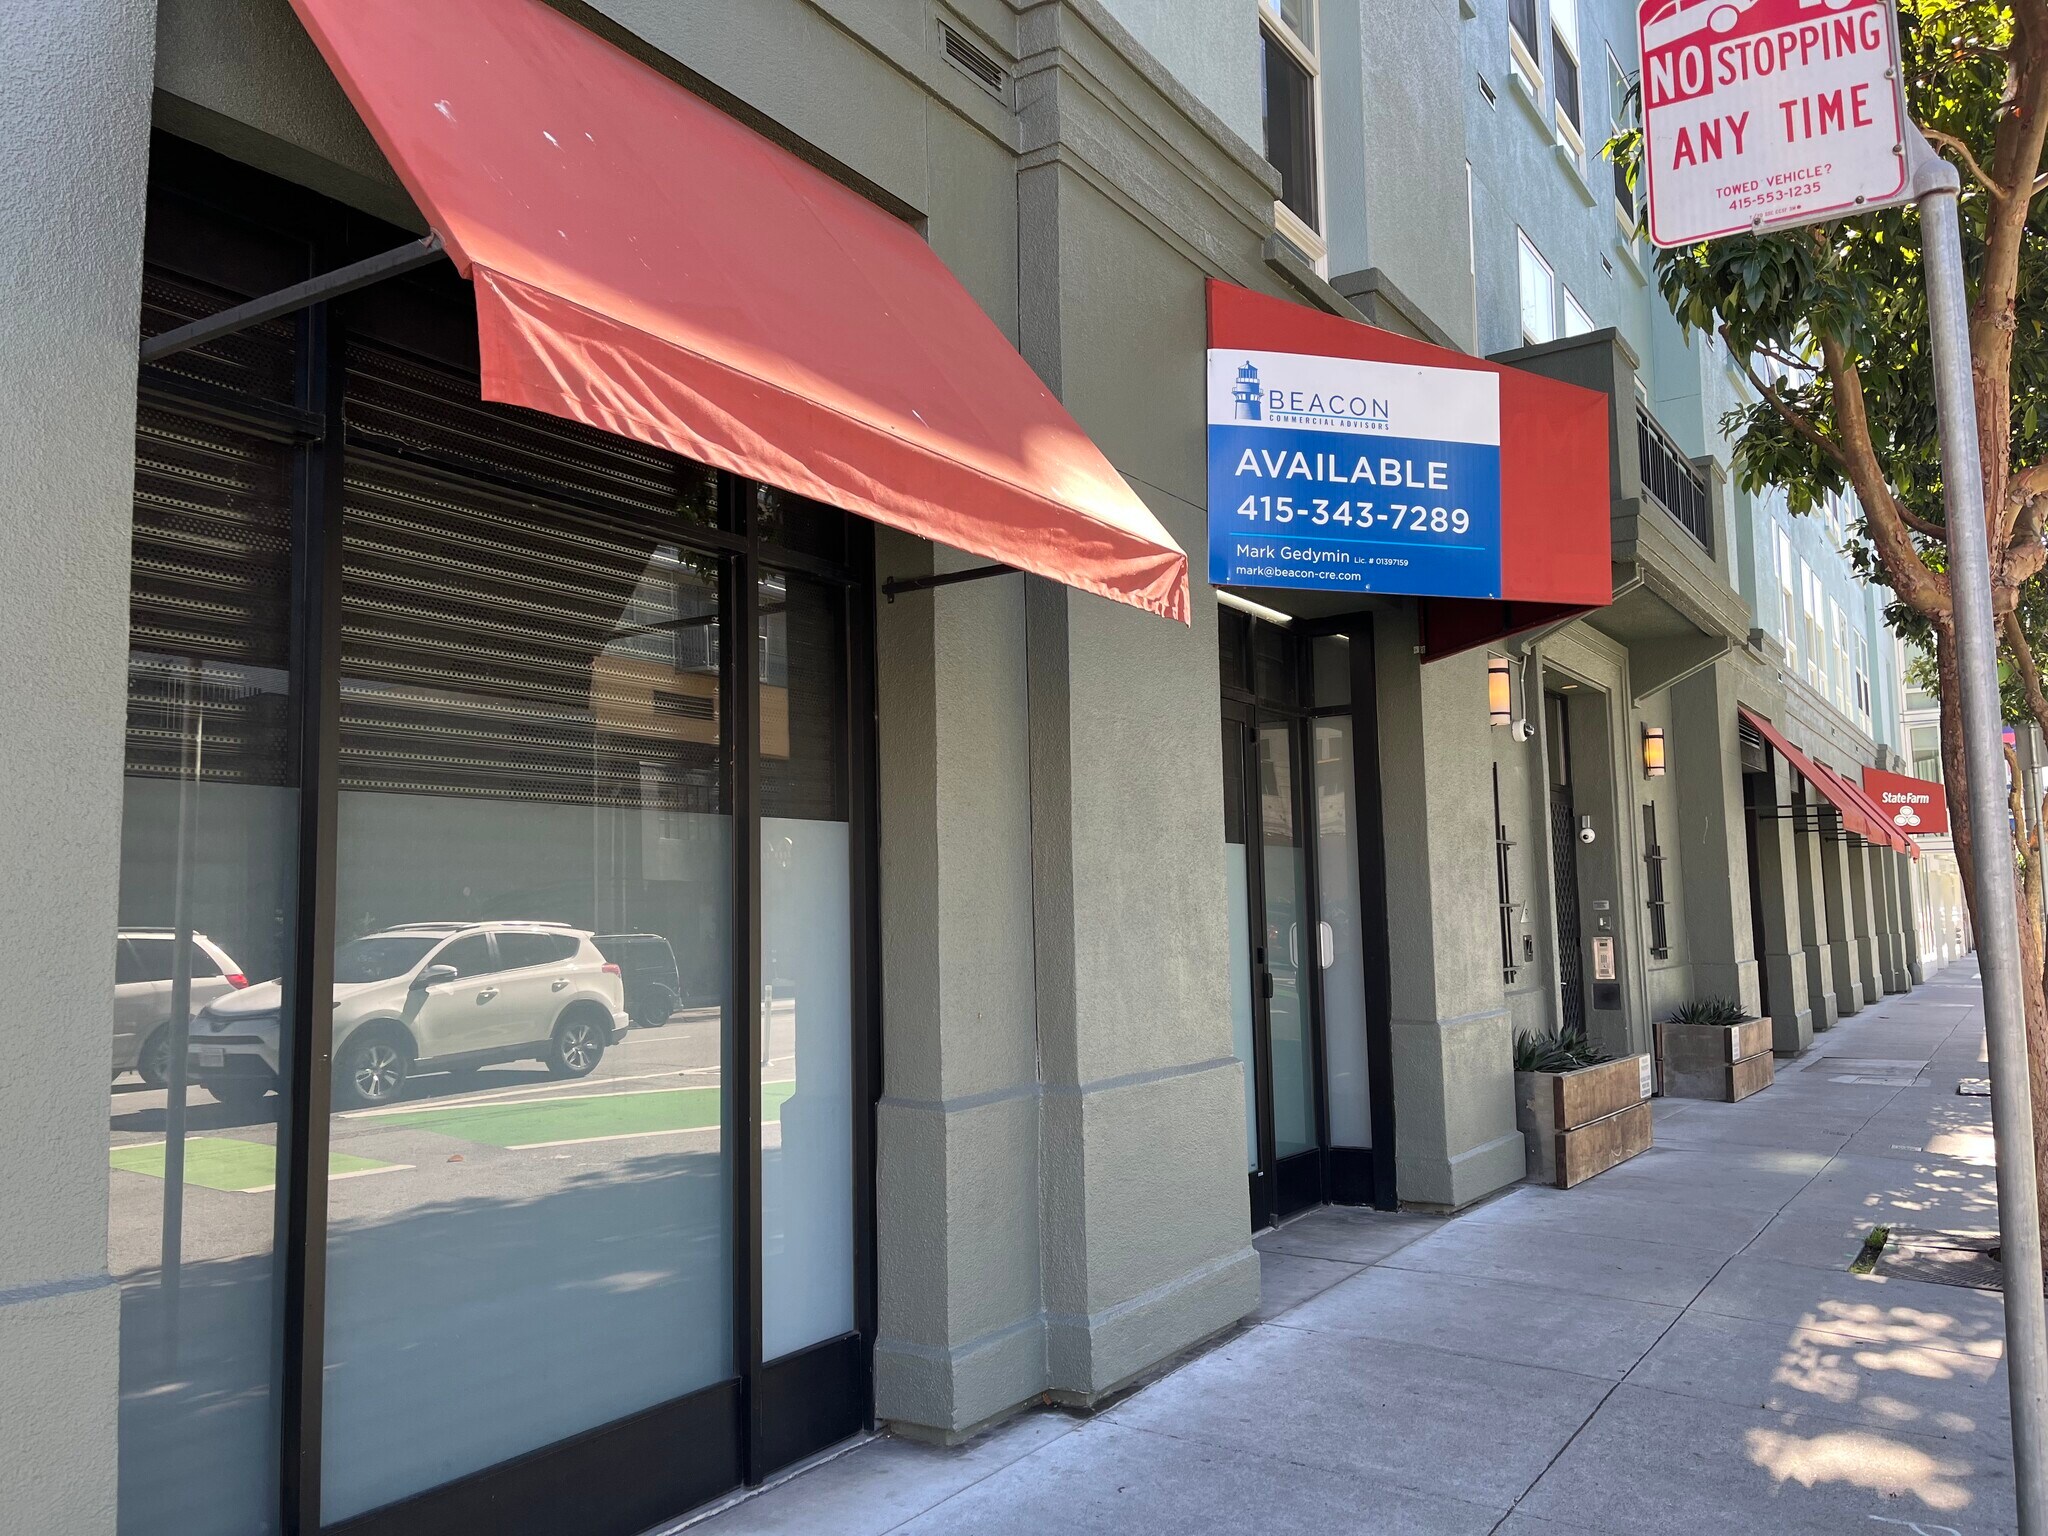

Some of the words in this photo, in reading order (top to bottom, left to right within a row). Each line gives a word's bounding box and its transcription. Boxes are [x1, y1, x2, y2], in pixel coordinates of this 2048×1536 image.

[1650, 45, 1705, 104] NO
[1717, 10, 1881, 86] STOPPING
[1672, 111, 1750, 170] ANY
[1779, 82, 1873, 143] TIME
[1716, 180, 1759, 199] TOWED
[1766, 163, 1833, 188] VEHICLE?
[1729, 182, 1821, 210] 415-553-1235
[1269, 389, 1389, 419] BEACON
[1269, 414, 1335, 427] COMMERCIAL
[1339, 419, 1389, 431] ADVISORS
[1235, 448, 1448, 490] AVAILABLE
[1236, 495, 1470, 534] 415-343-7289
[1236, 543, 1275, 560] Mark
[1280, 546, 1350, 564] Gedymin
[1375, 558, 1409, 567] 01397159
[1236, 565, 1362, 582] mark@beacon-cre.com
